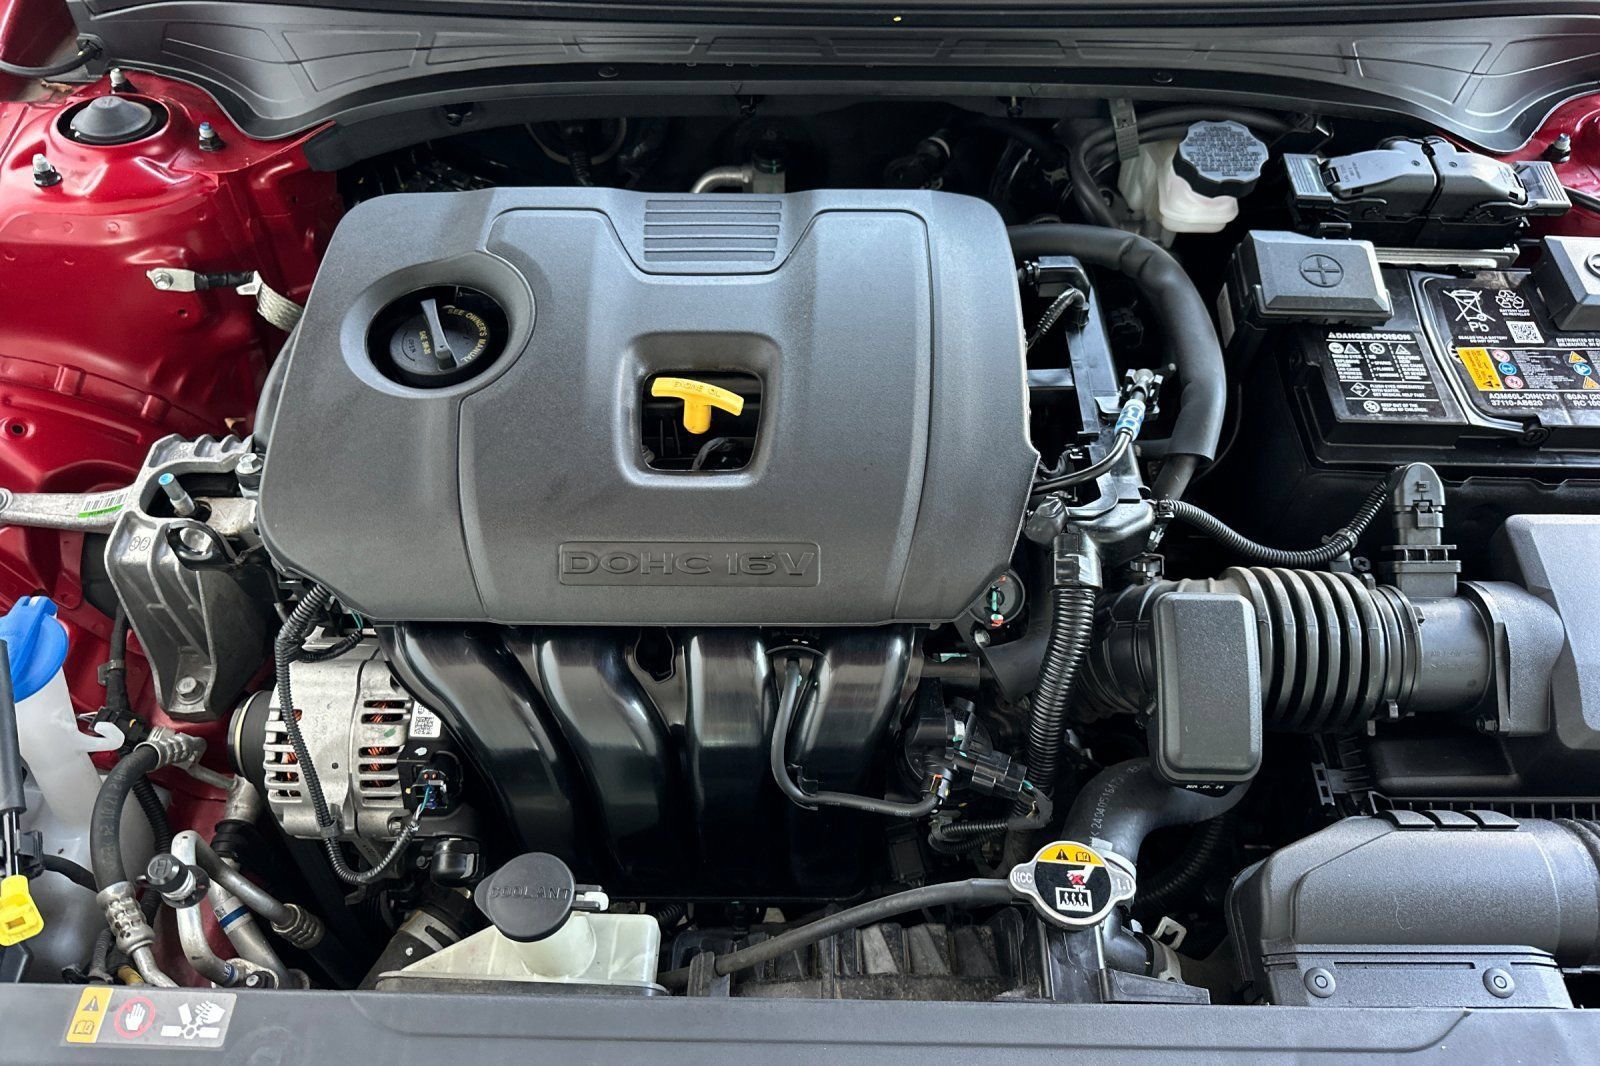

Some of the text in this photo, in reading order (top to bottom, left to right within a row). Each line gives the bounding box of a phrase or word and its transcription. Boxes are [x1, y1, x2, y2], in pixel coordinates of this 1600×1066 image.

[1468, 321, 1489, 332] Pb
[447, 308, 488, 362] SEE OWNER'S MANUAL
[1335, 332, 1411, 340] DANGER/POISON
[563, 551, 815, 576] DOHC 16V
[488, 885, 572, 900] COOLANT
